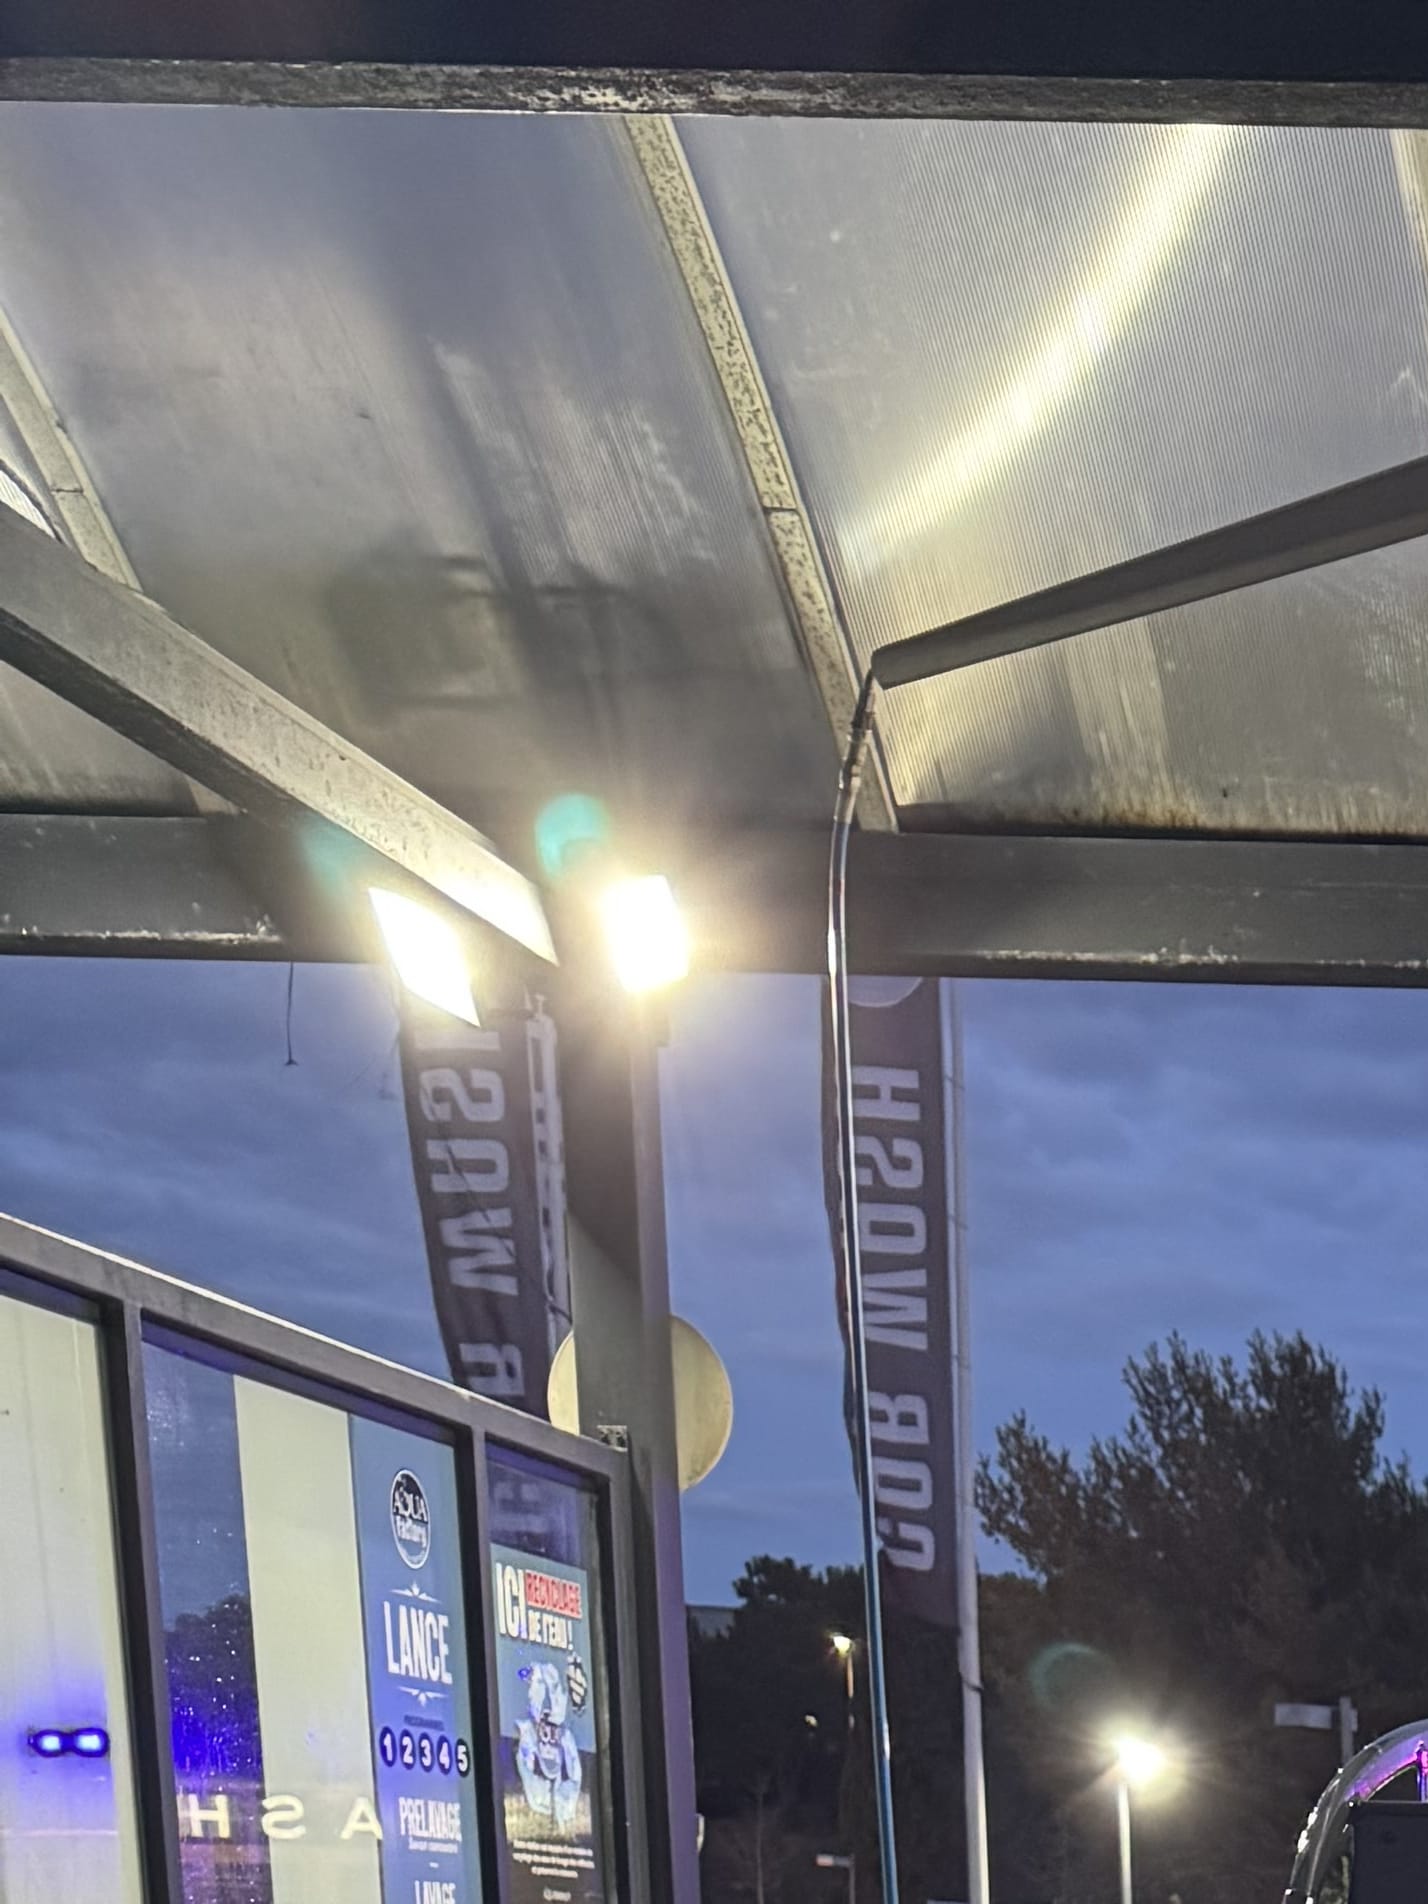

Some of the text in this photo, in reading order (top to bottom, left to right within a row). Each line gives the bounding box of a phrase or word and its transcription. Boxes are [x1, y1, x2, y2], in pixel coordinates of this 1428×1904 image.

[496, 1562, 582, 1640] ICI RECYCLAGE
[383, 1601, 453, 1684] LANCE
[528, 1610, 541, 1643] DE
[383, 1734, 468, 1772] 1 2 3 4 5
[399, 1797, 462, 1842] PRELAVAGE
